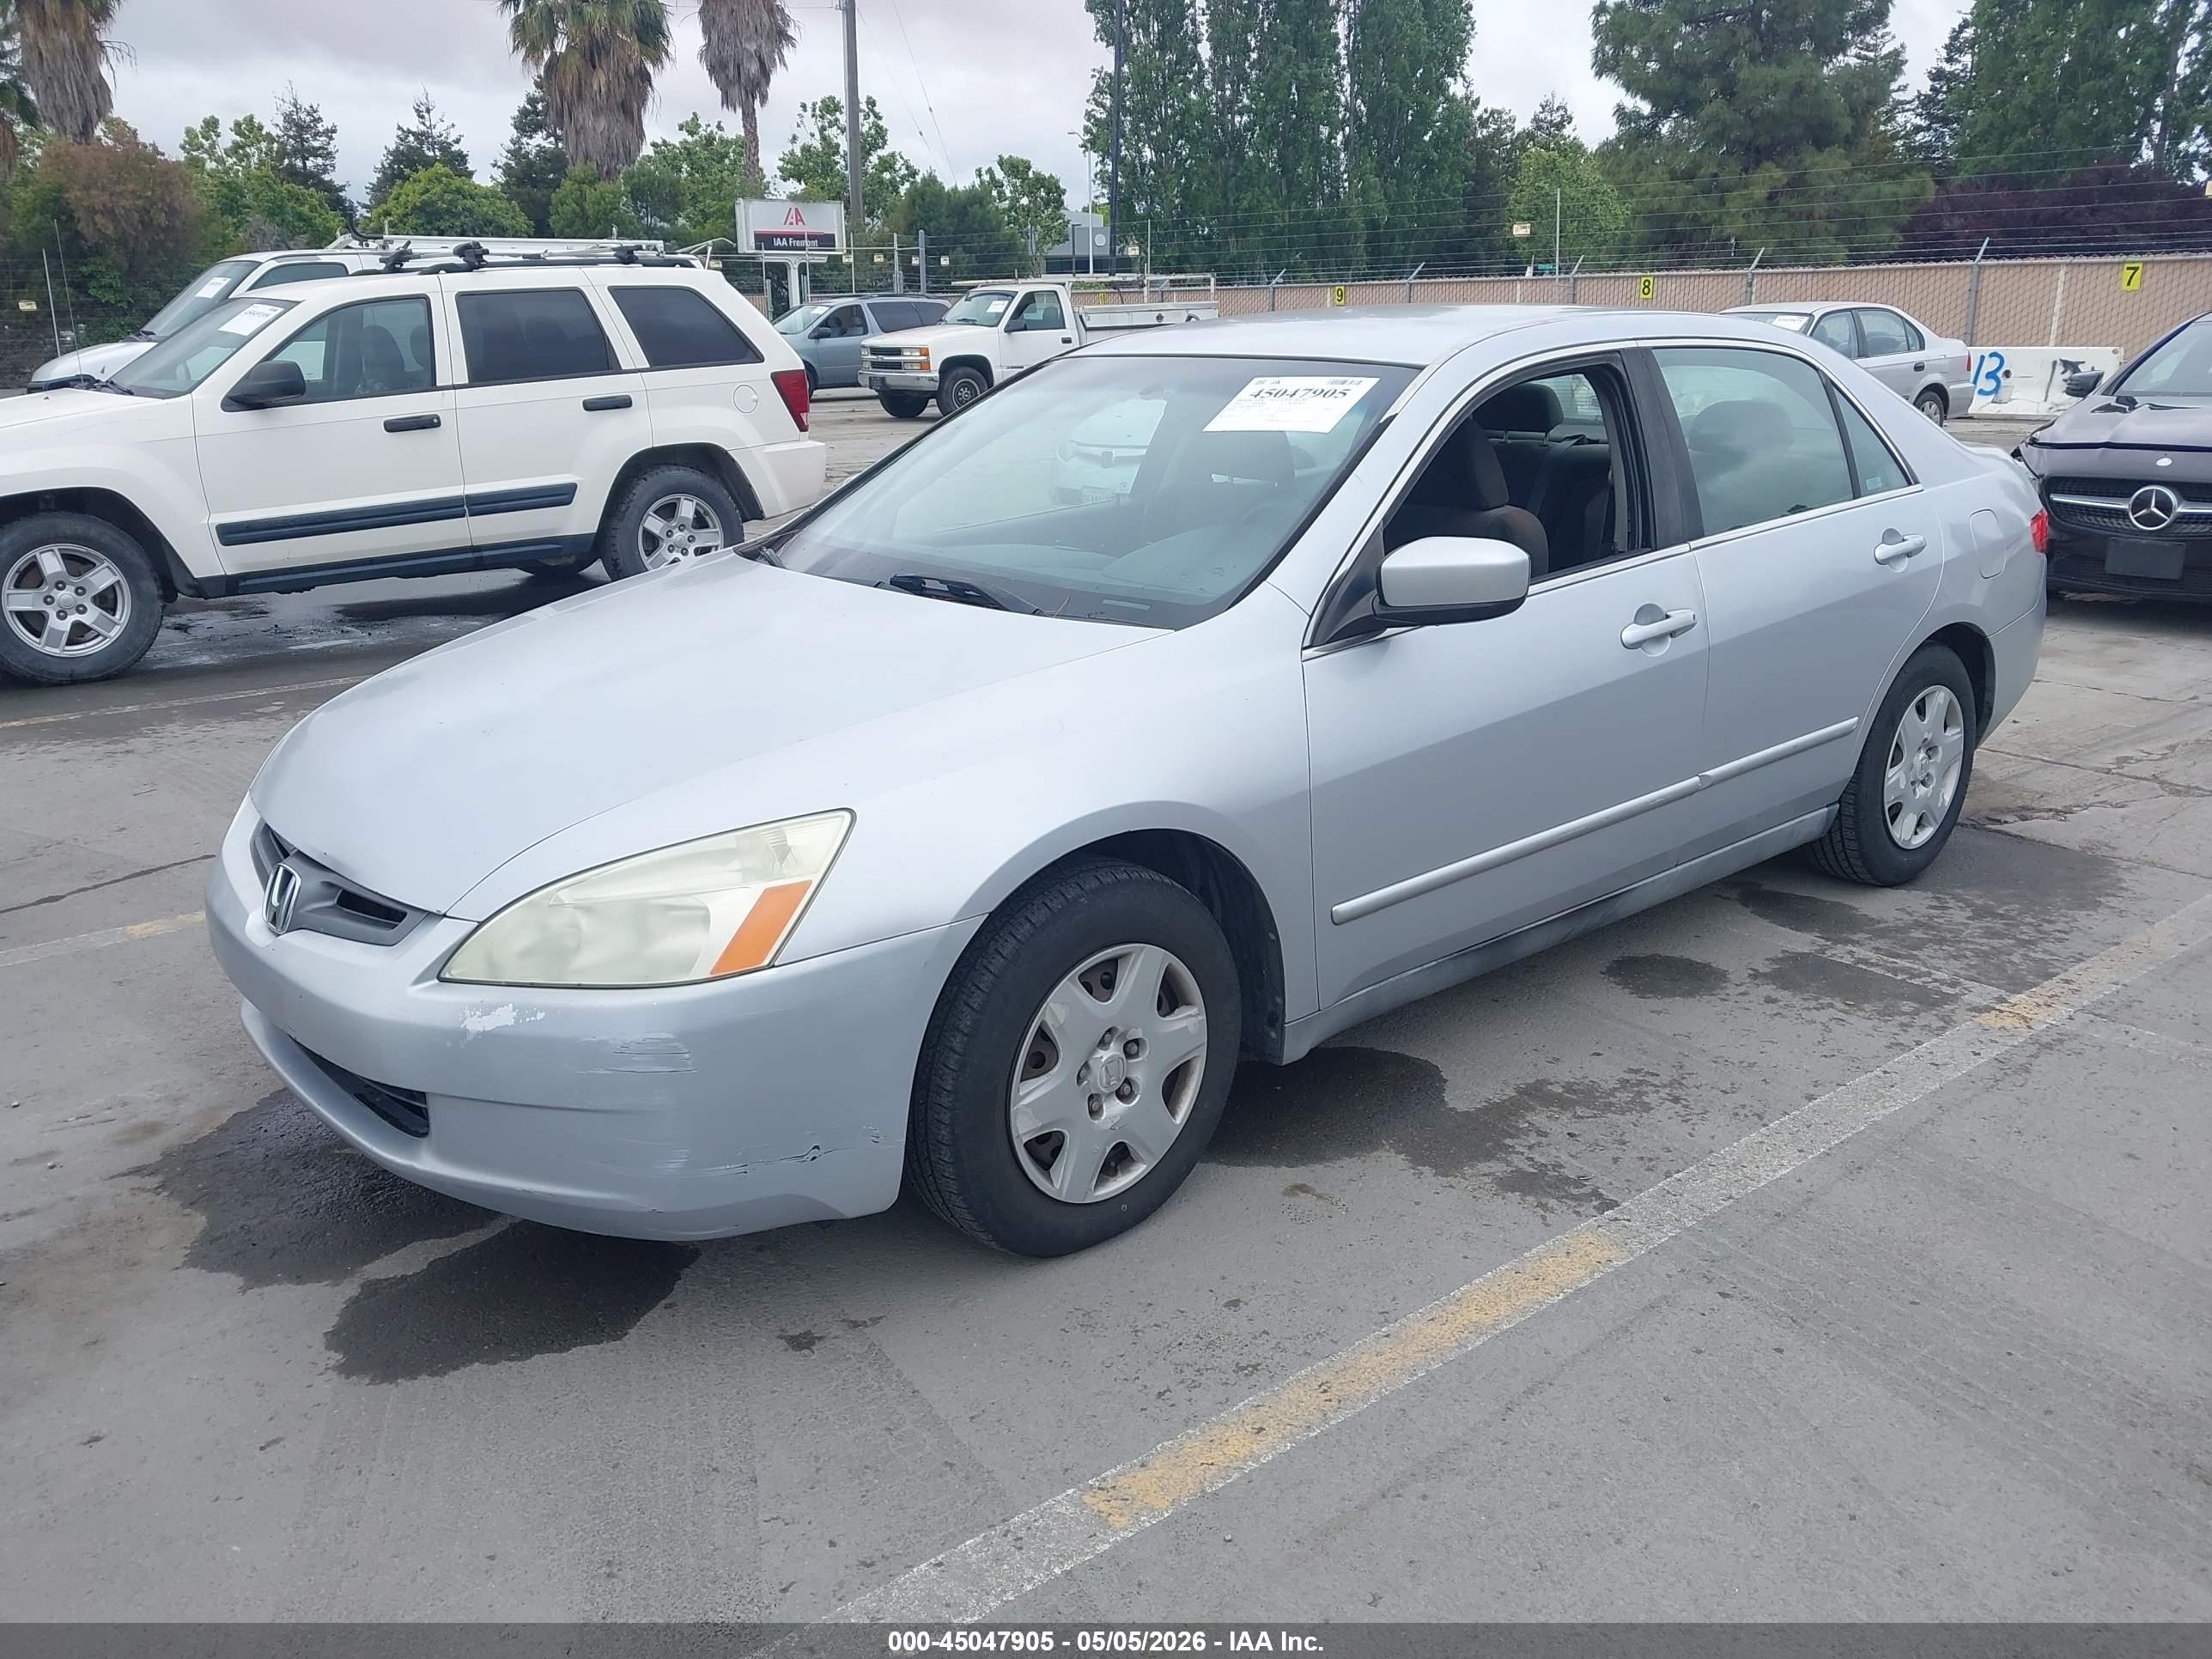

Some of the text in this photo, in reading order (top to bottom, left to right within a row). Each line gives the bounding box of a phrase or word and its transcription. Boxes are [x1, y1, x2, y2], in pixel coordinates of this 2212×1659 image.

[773, 237, 818, 247] IAA Fremont
[2126, 266, 2140, 287] 7
[1336, 288, 1343, 302] 9
[1642, 279, 1650, 296] 8
[1972, 351, 2005, 396] 13
[1250, 388, 1351, 398] 45047905
